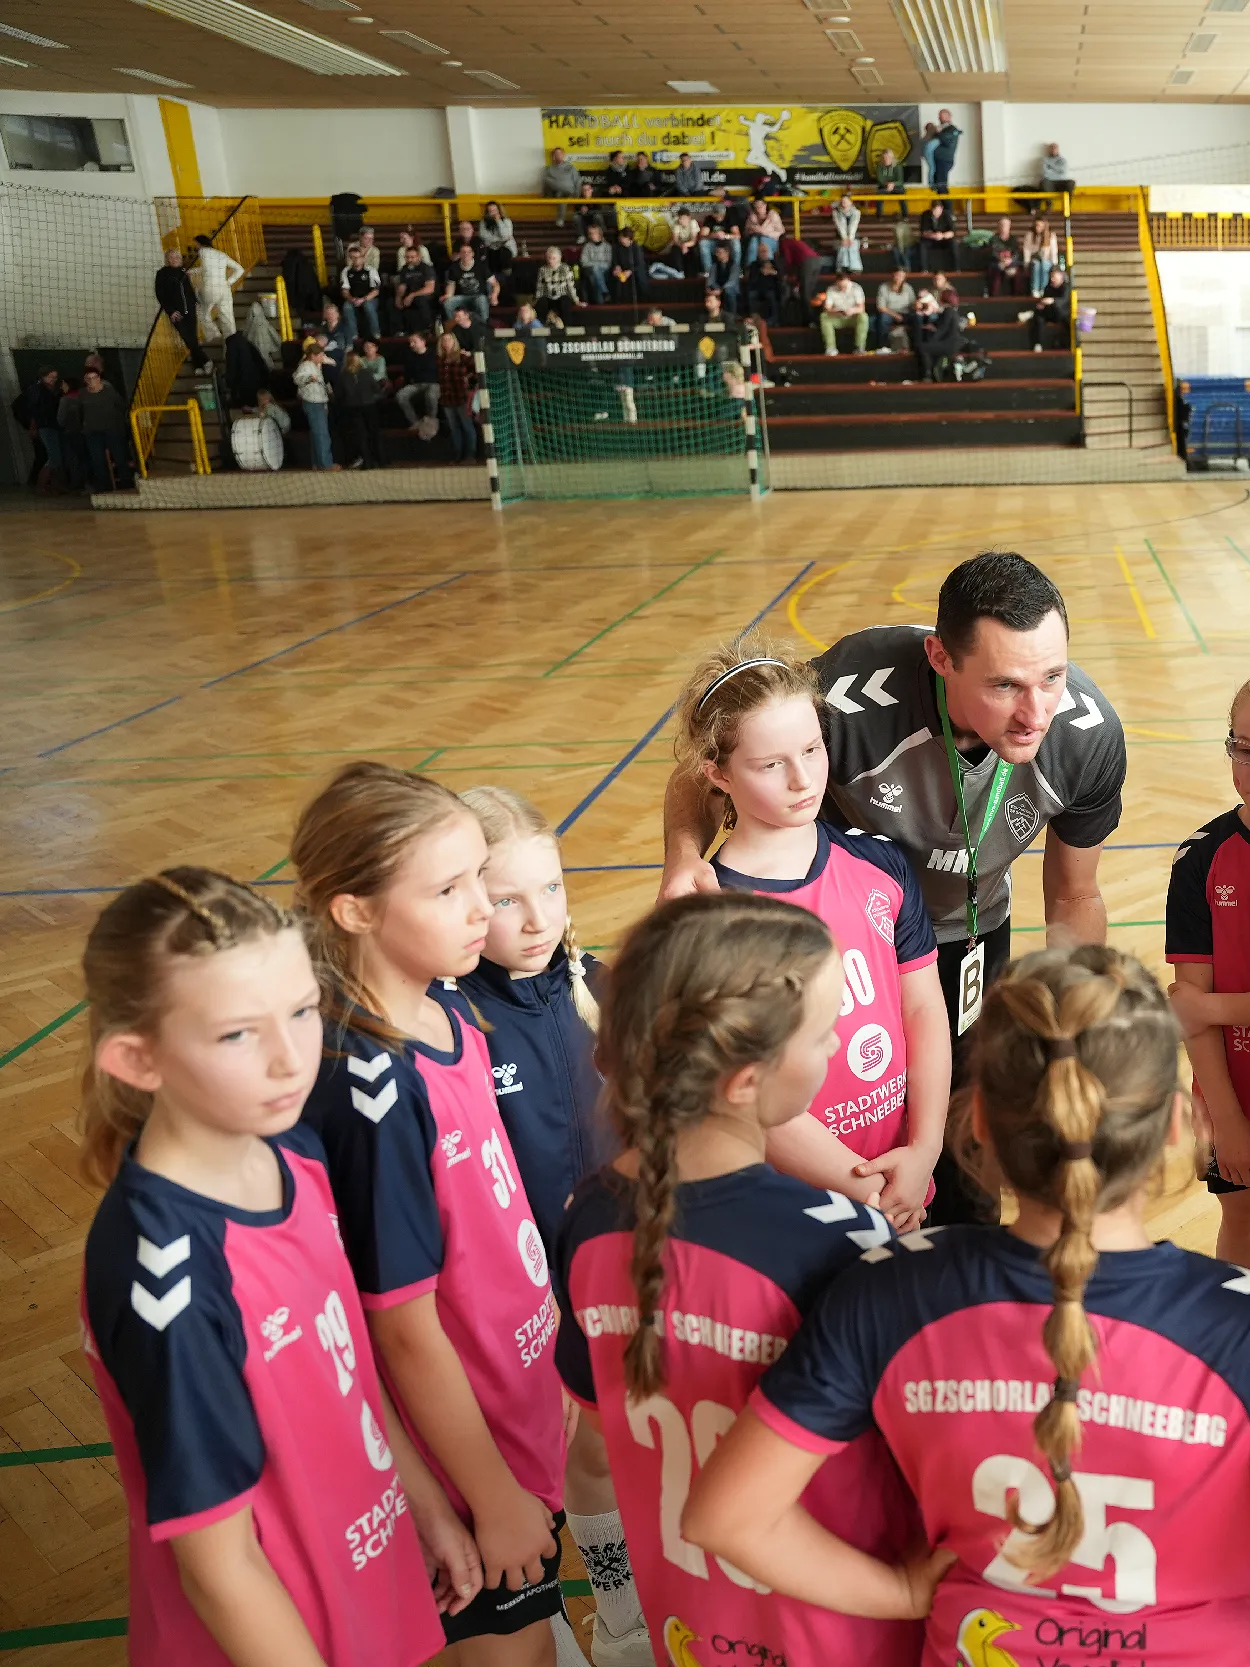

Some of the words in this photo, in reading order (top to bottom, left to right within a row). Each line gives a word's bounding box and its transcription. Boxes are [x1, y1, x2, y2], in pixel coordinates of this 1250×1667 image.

[548, 114, 640, 129] HANDBALL
[645, 113, 721, 128] verbindet
[568, 133, 590, 147] sei
[595, 132, 633, 147] auch
[637, 131, 657, 146] du
[662, 131, 706, 146] dabei
[547, 342, 560, 354] SG
[869, 797, 902, 813] hummel
[1214, 899, 1238, 907] hummel
[962, 959, 981, 1015] B
[824, 1067, 907, 1123] STADTWERK
[934, 1379, 1056, 1413] ZSCHORLA
[1076, 1389, 1228, 1447] SCHNEEBERG
[972, 1453, 1157, 1615] 25
[591, 1570, 633, 1592] WERK
[1035, 1617, 1147, 1659] Original
